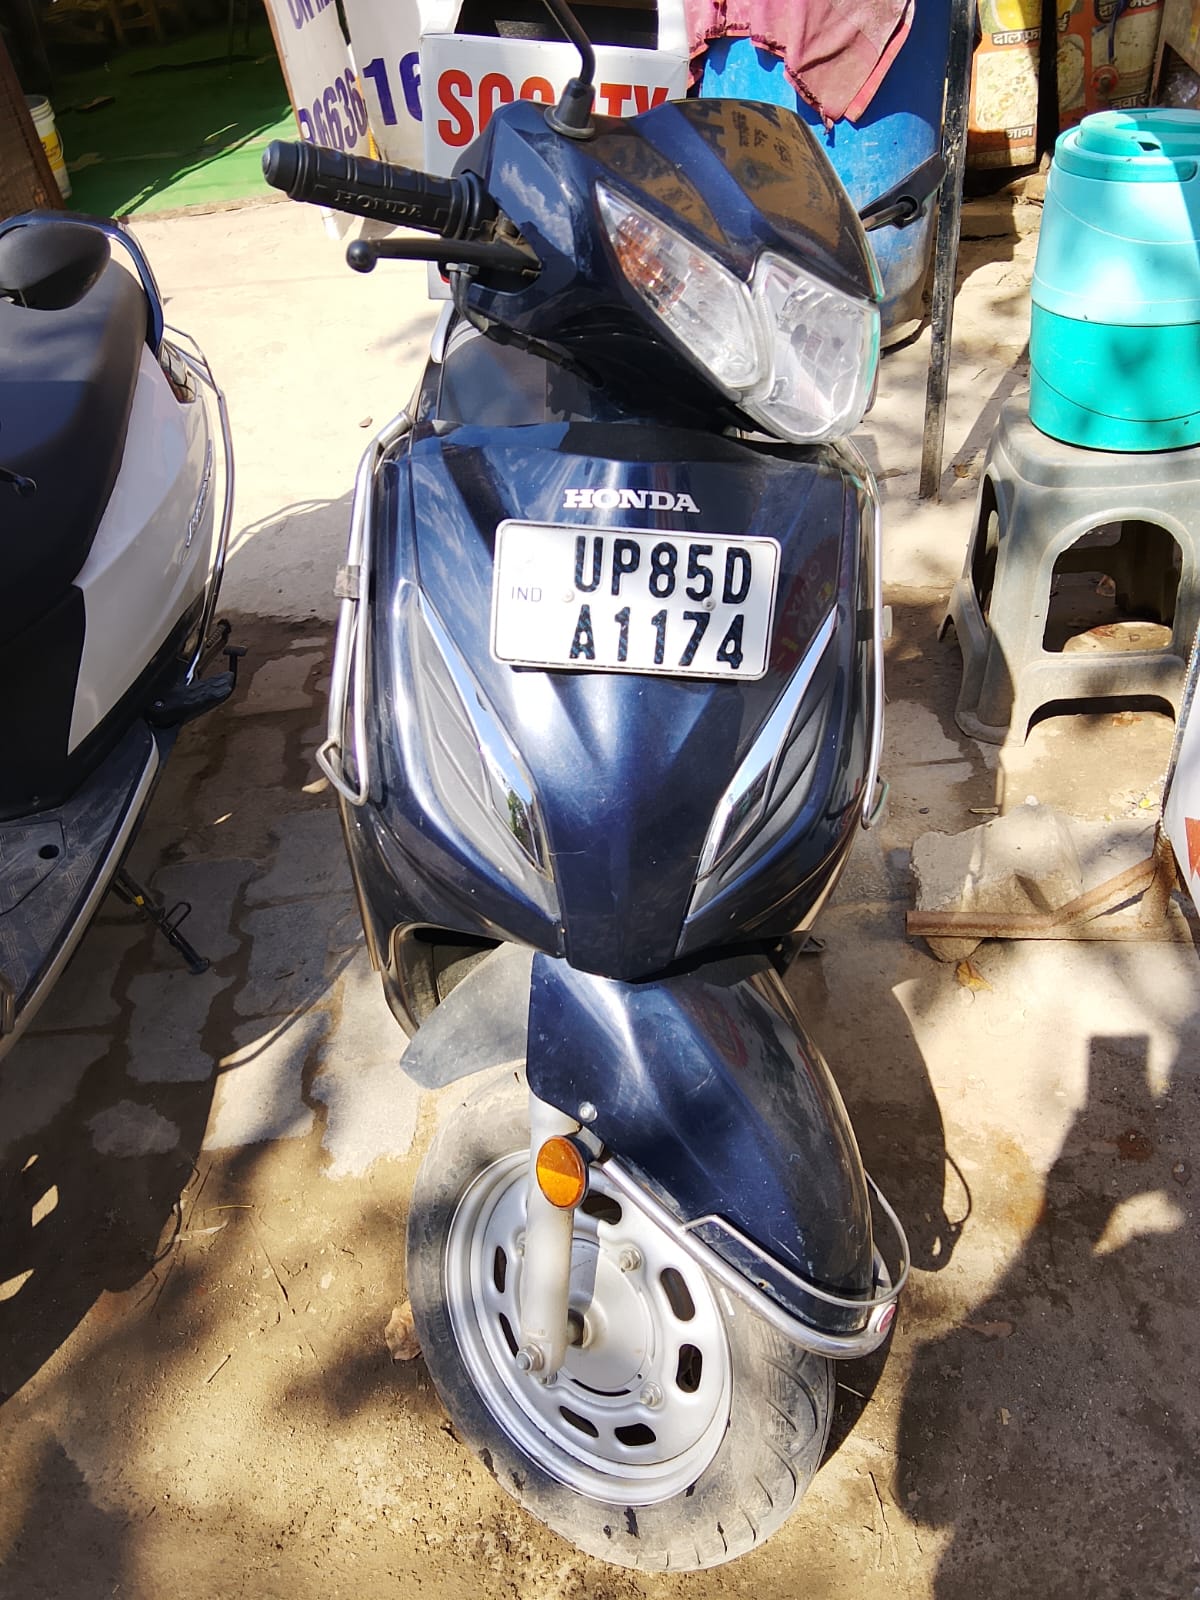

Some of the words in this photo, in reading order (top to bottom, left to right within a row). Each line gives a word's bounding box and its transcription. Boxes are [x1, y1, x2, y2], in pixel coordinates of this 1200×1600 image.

[563, 488, 701, 513] HONDA
[573, 535, 751, 604] UP85D
[510, 585, 543, 603] IND
[568, 603, 745, 670] A1174
